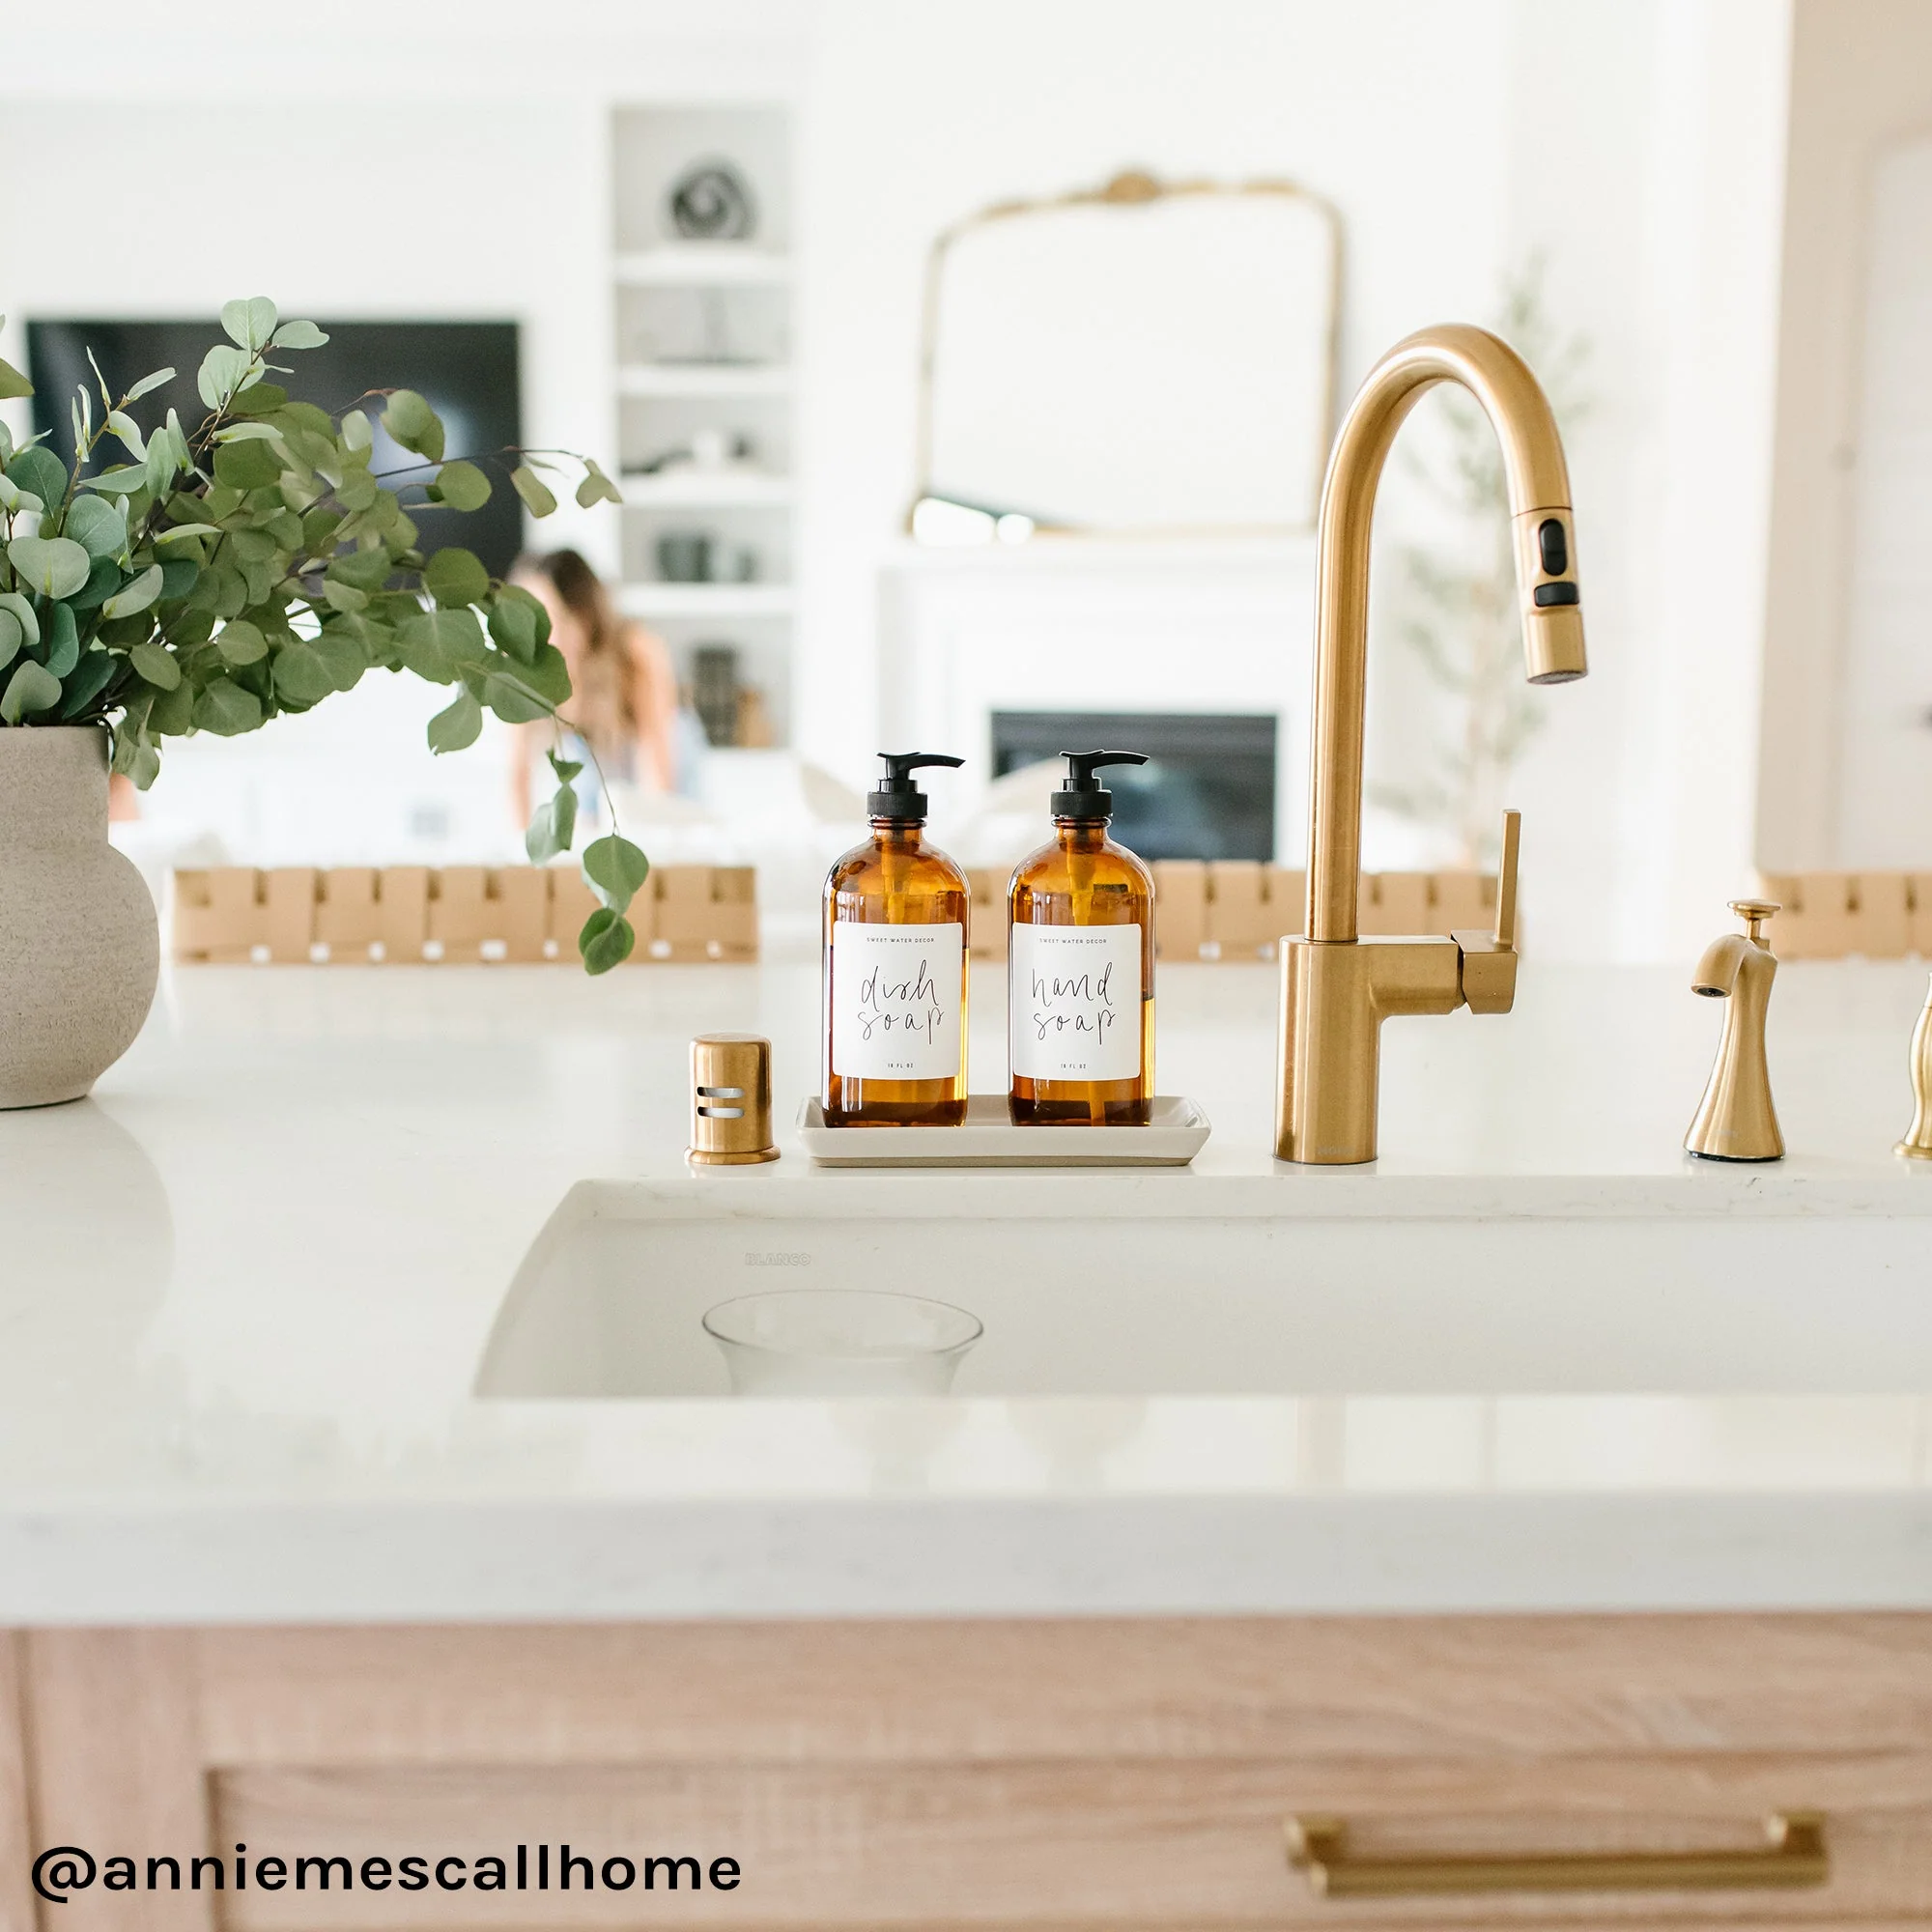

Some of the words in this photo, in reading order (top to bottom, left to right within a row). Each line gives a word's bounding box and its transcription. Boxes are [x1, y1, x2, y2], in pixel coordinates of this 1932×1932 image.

[861, 959, 939, 1012] dish
[1031, 961, 1113, 1008] hand
[857, 1007, 945, 1045] soap
[1033, 1009, 1116, 1045] soap
[745, 1252, 811, 1266] BLANCO
